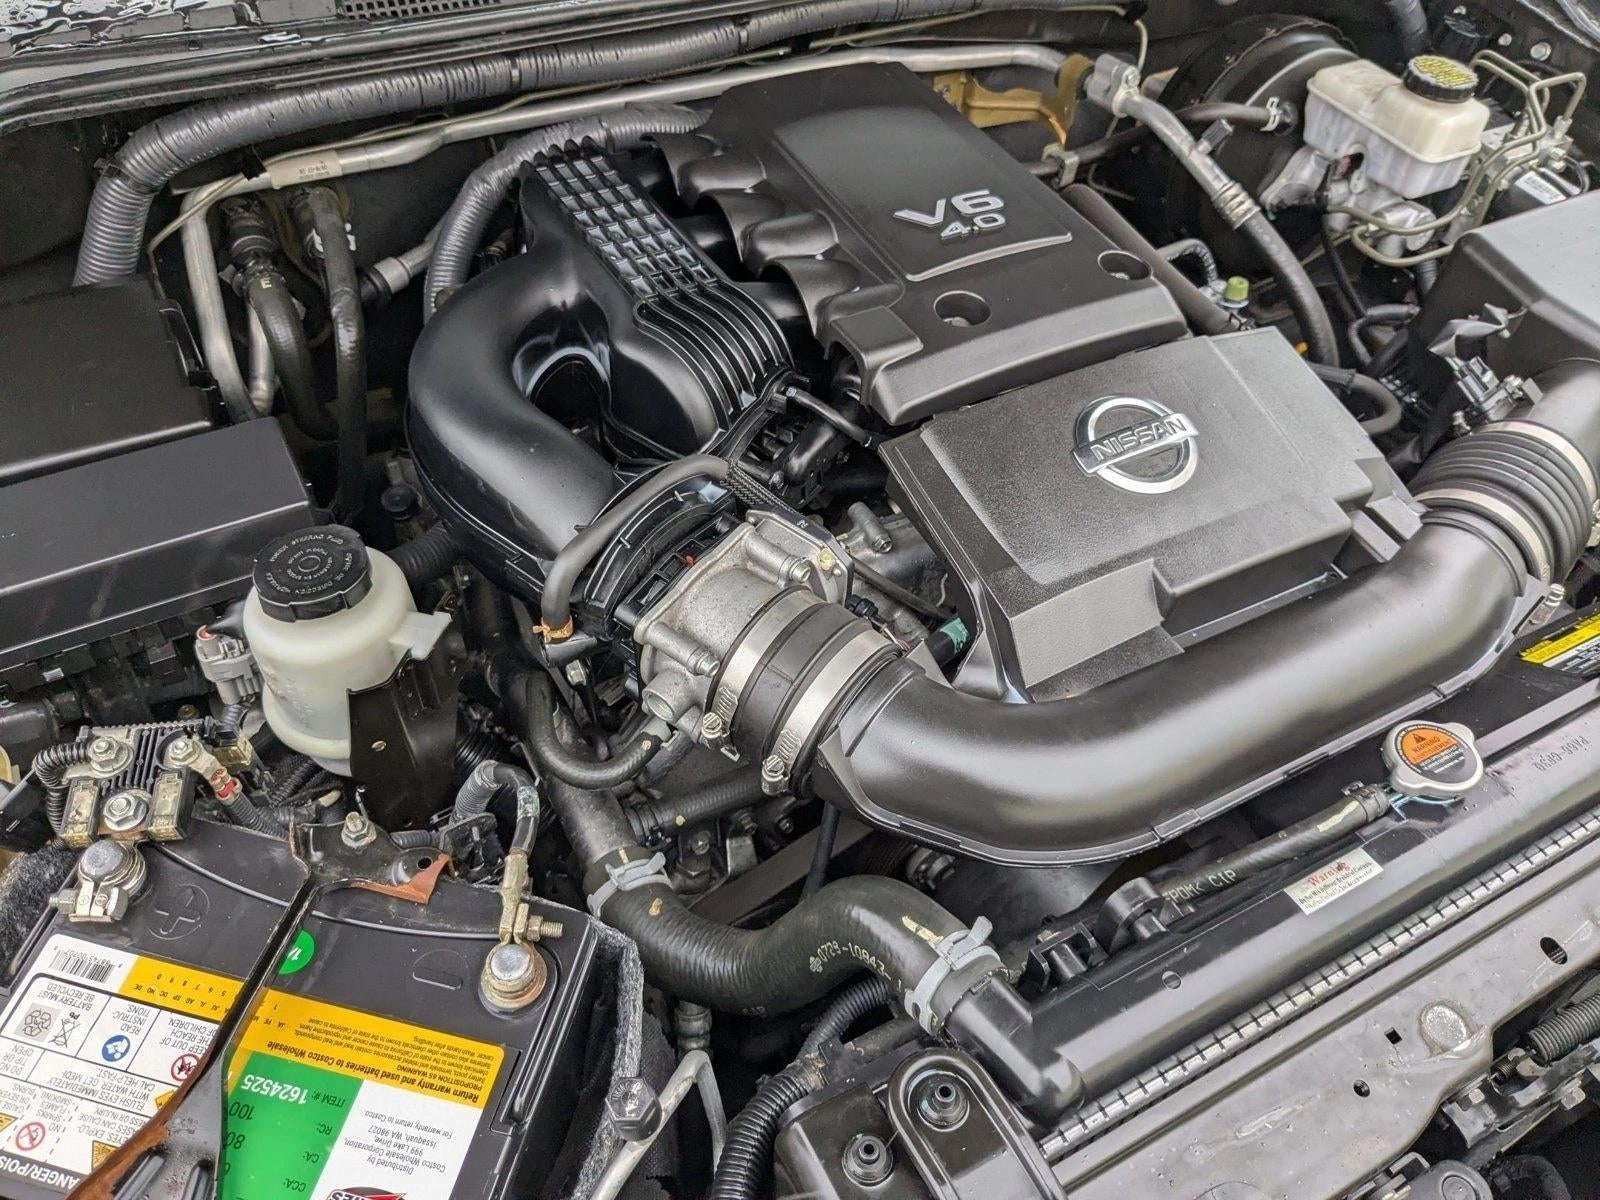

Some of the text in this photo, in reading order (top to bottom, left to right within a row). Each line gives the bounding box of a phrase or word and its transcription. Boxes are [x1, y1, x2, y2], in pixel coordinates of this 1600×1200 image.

[893, 188, 1004, 227] V6
[940, 213, 1006, 240] 4.0
[1090, 417, 1187, 461] NISSAN
[37, 989, 92, 1010] BATTERY MUST
[45, 982, 95, 1001] BE RECYCLED.
[68, 1011, 80, 1019] Pb
[110, 1010, 147, 1025] INSTRUC-
[125, 1003, 151, 1017] TIONS.
[119, 1022, 142, 1034] READ
[166, 1017, 207, 1034] CHILDREN.
[170, 1028, 197, 1042] REACH
[159, 1036, 171, 1045] OF
[170, 1039, 189, 1050] OUT
[94, 1068, 155, 1091] CAL HELP FAST.
[265, 1040, 479, 1102] Return warranty and used batteries to Costco Wholesale
[396, 1064, 428, 1076] WARNING
[60, 1070, 150, 1100] WITH WATER. GET MEDI-
[240, 1073, 311, 1104] 1624525
[437, 1074, 482, 1091] PROPOSITION
[46, 1076, 145, 1110] FLUSH EYES IMMEDIATELY
[324, 1094, 345, 1107] ITEM
[47, 1122, 61, 1132] NO
[77, 1112, 117, 1129] CAN CAUSE
[227, 1101, 333, 1135] RC: 100
[362, 1110, 453, 1140] For warranty, return to Costco.
[367, 1124, 437, 1148] Issaquah, WA 98027
[341, 1137, 446, 1172] Costco Wholesale Corporation,
[371, 1136, 424, 1156] 999 Lake Drive,
[301, 1151, 320, 1163] CA:
[366, 1155, 414, 1174] Distributed by
[0, 1155, 80, 1190] ANGER/POIS
[282, 1178, 307, 1191] CCA:
